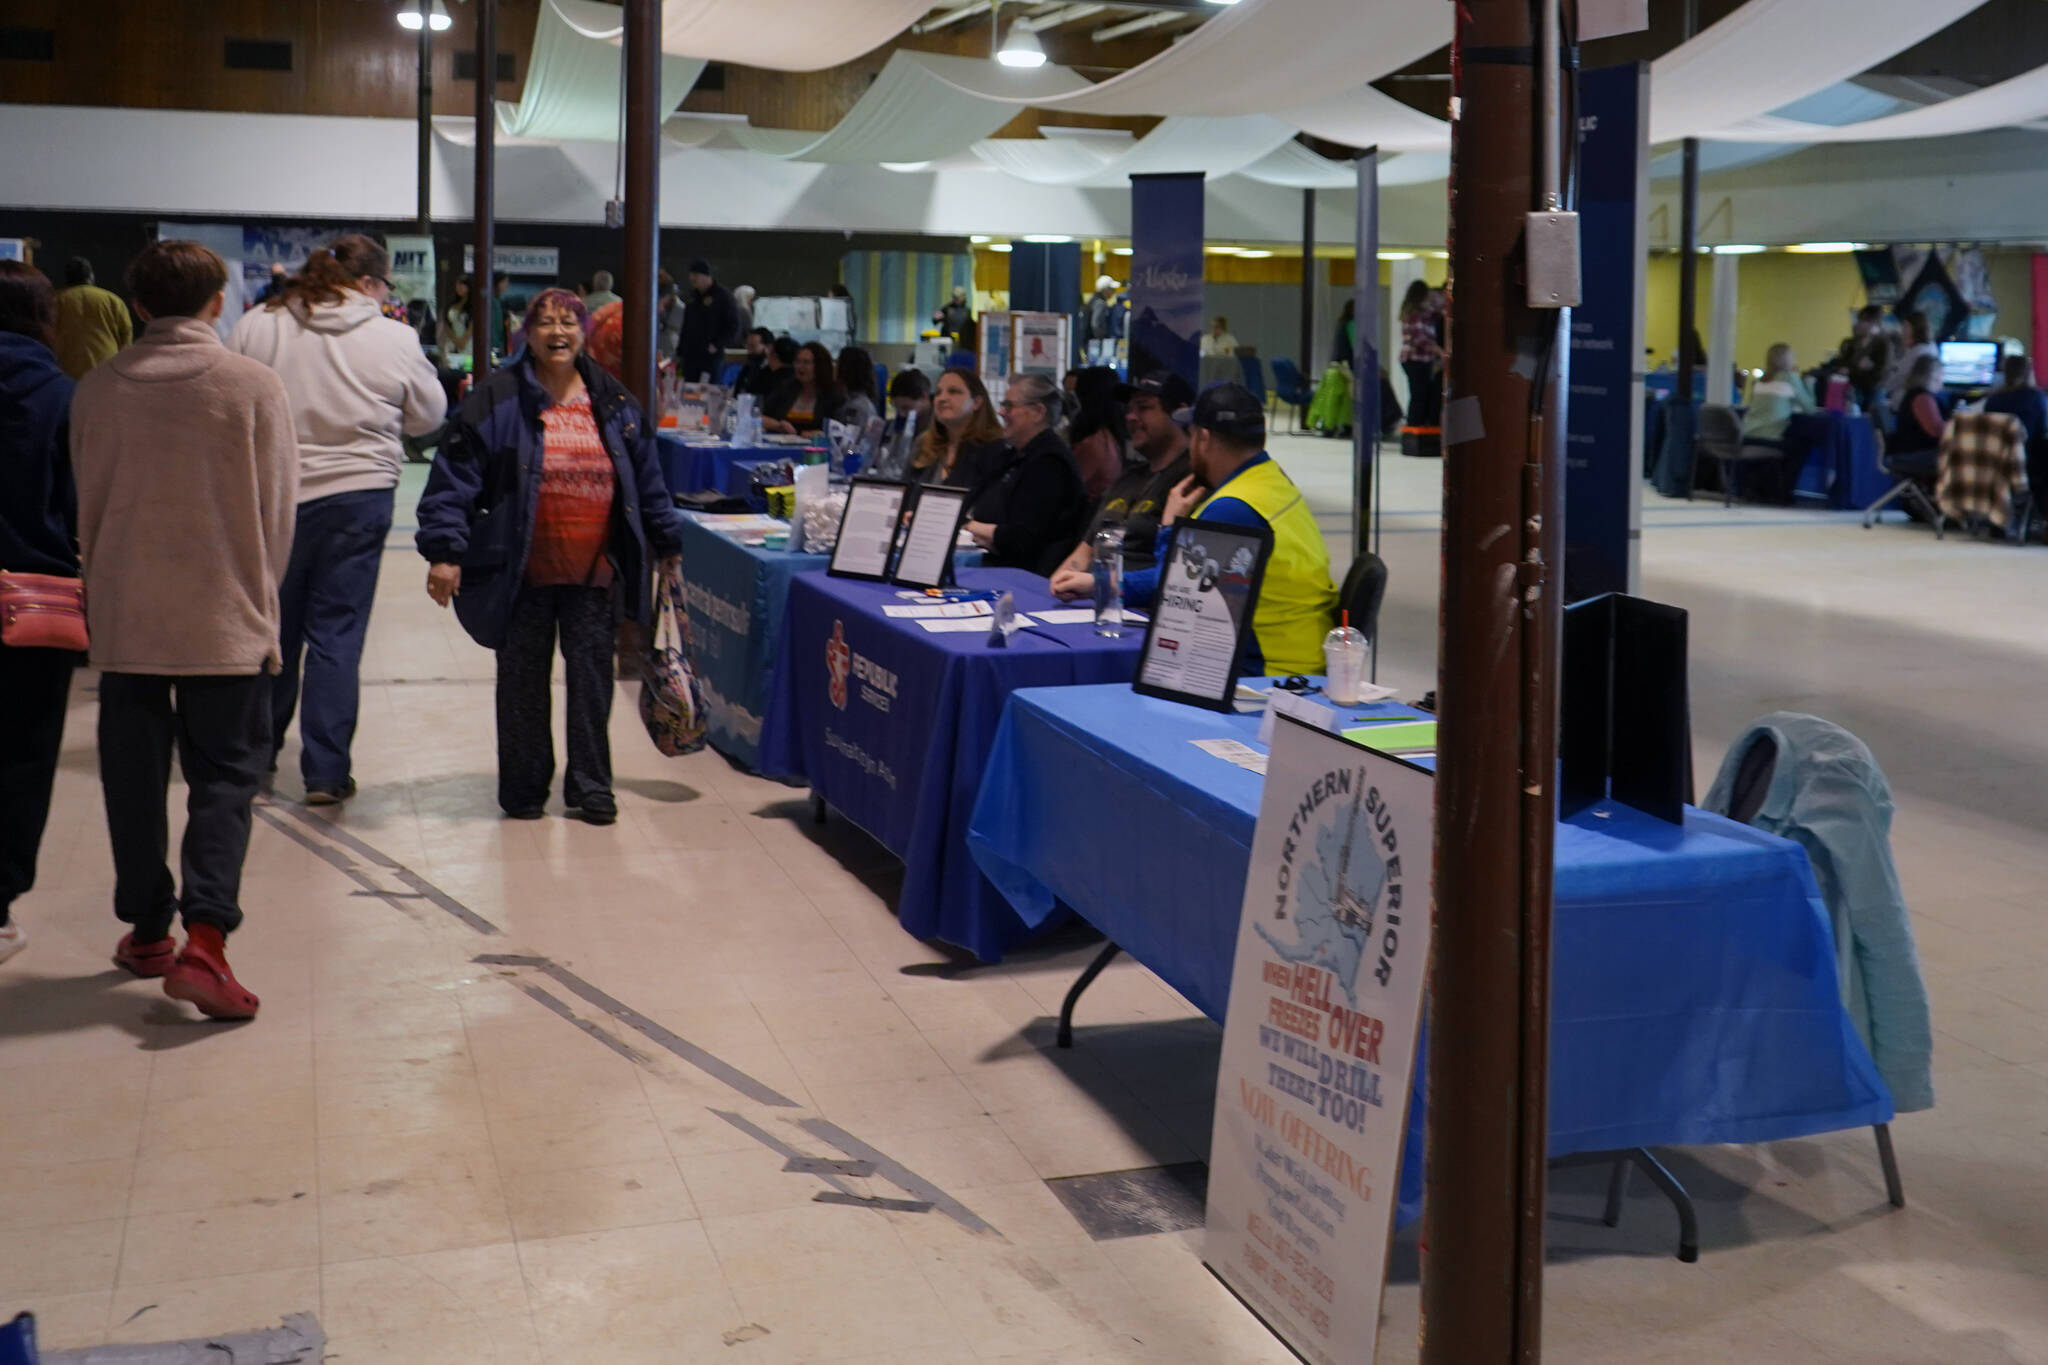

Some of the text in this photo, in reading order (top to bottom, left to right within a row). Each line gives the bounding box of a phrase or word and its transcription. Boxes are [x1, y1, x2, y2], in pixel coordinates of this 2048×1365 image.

[1161, 594, 1204, 613] HIRING
[1275, 768, 1351, 920] NORTHERN
[1365, 786, 1402, 987] SUPERIOR
[1262, 960, 1333, 1012] WHEN HELL
[1259, 1024, 1383, 1107] WE WILL DRILL
[1268, 996, 1384, 1065] FREEZES OVER
[1268, 1062, 1367, 1134] THERE TOO!
[1240, 1077, 1275, 1130] NOW
[1280, 1111, 1372, 1203] OFFERING
